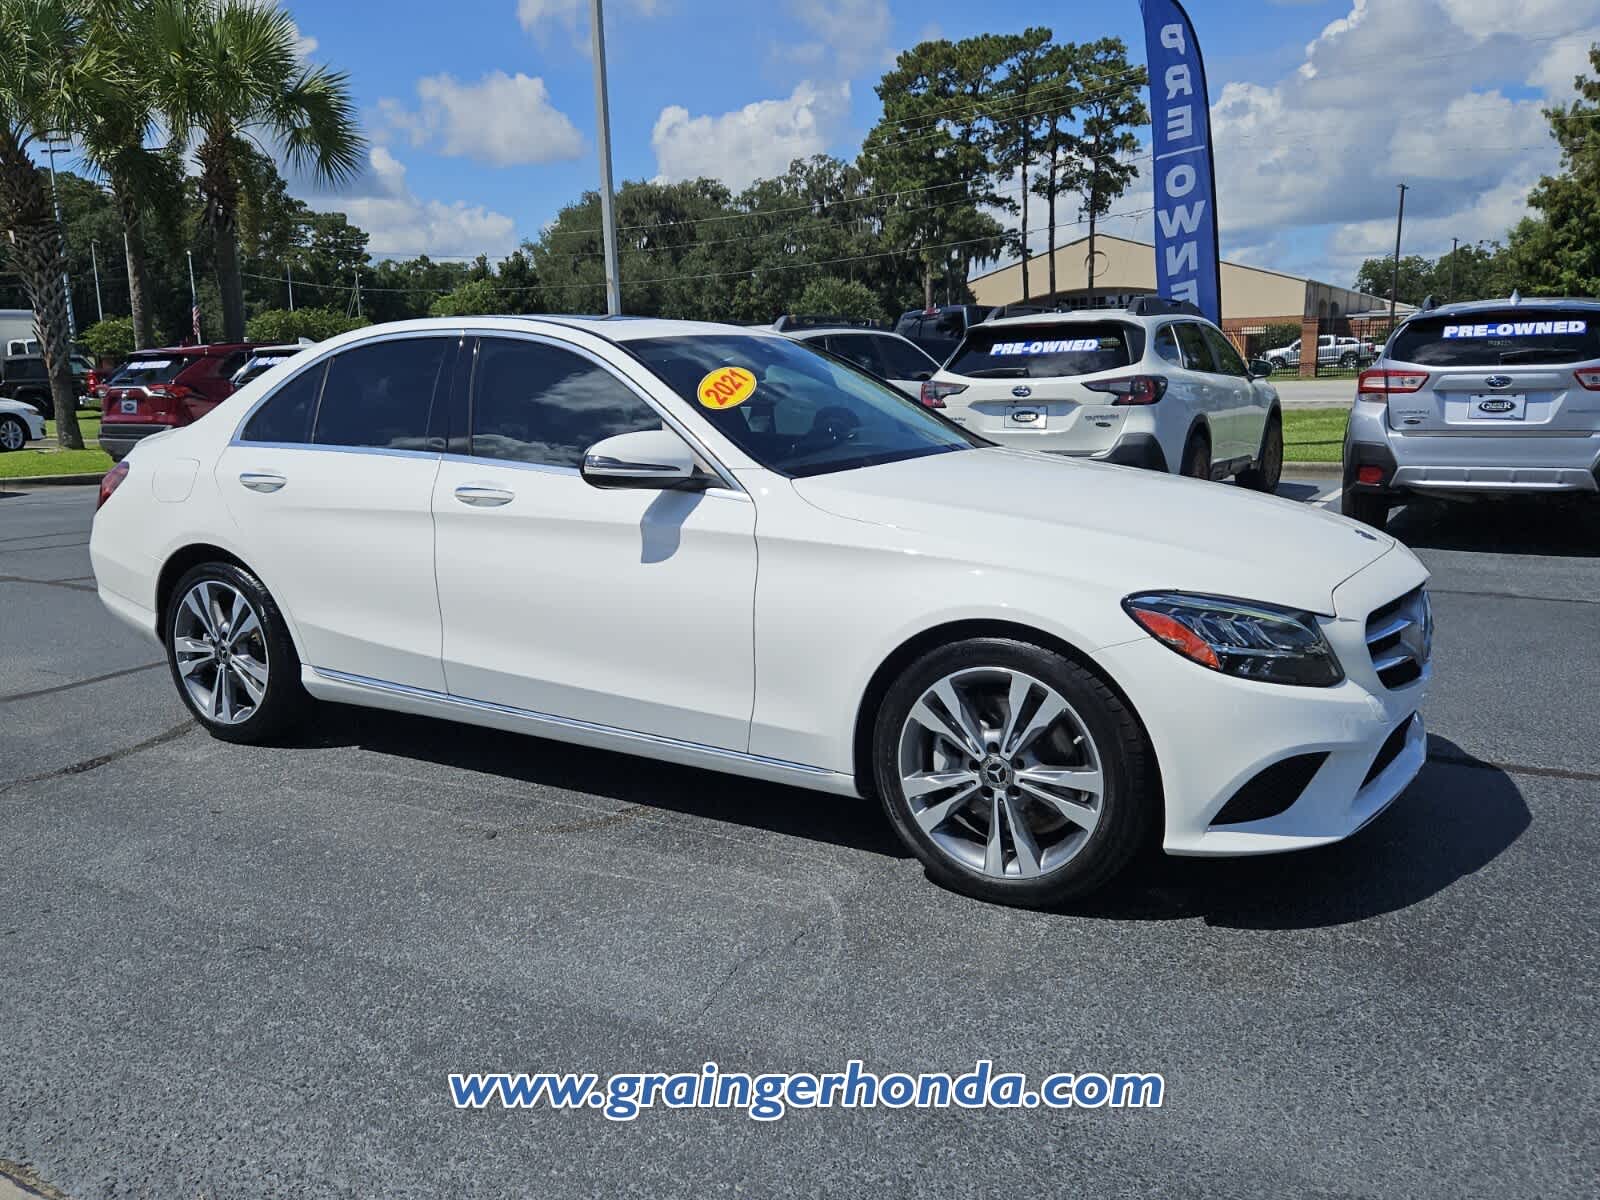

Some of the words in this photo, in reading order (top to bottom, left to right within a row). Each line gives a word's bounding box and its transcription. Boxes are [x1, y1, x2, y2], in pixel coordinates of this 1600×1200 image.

[1442, 320, 1587, 338] PRE-OWNED
[989, 339, 1099, 356] PRE-OWNED
[704, 368, 749, 406] 2021
